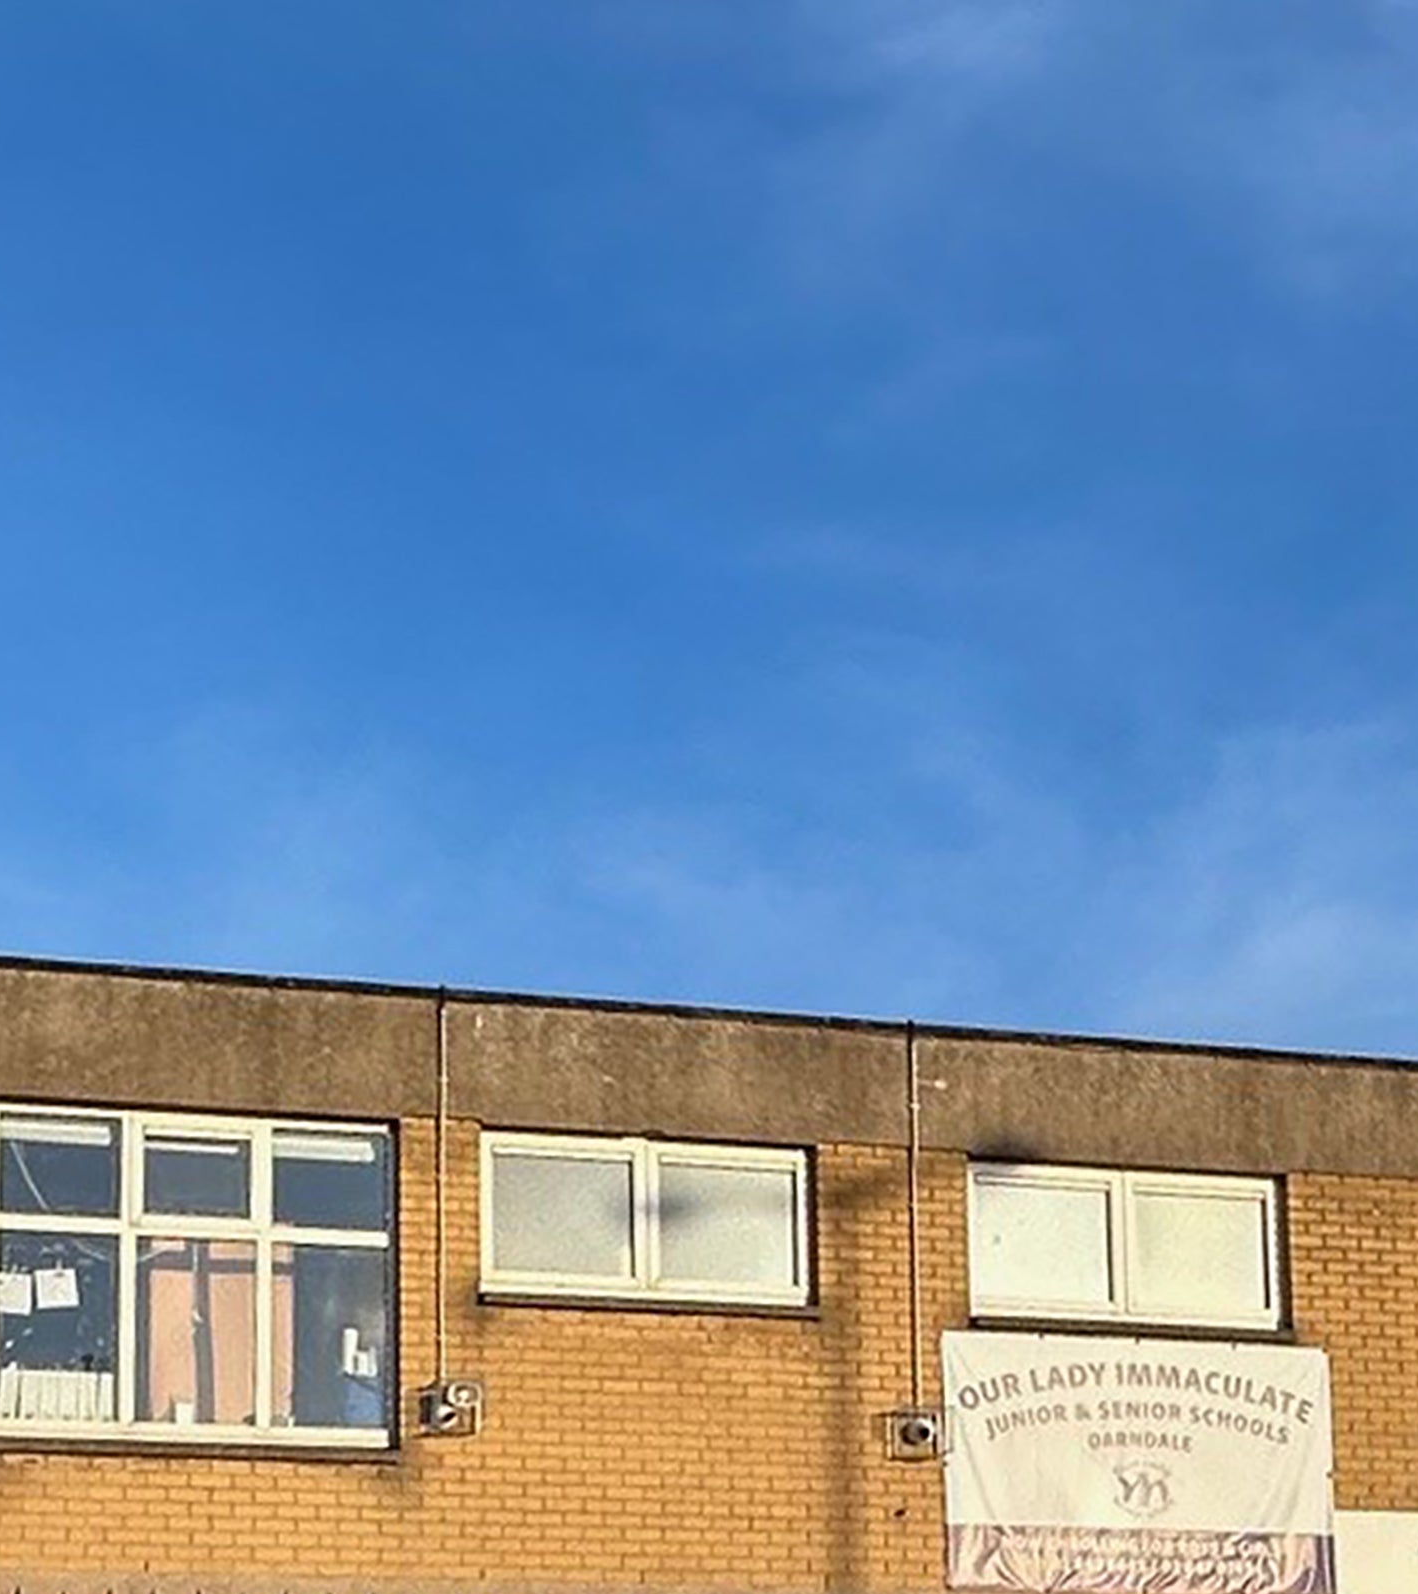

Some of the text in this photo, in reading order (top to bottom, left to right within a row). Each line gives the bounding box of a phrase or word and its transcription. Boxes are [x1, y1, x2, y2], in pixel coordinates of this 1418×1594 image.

[958, 1363, 1314, 1425] OUR LADY IMMACULATE
[985, 1404, 1068, 1441] JUNIOR
[1098, 1402, 1181, 1421] SENIOR
[1189, 1405, 1290, 1445] SCHOOLS
